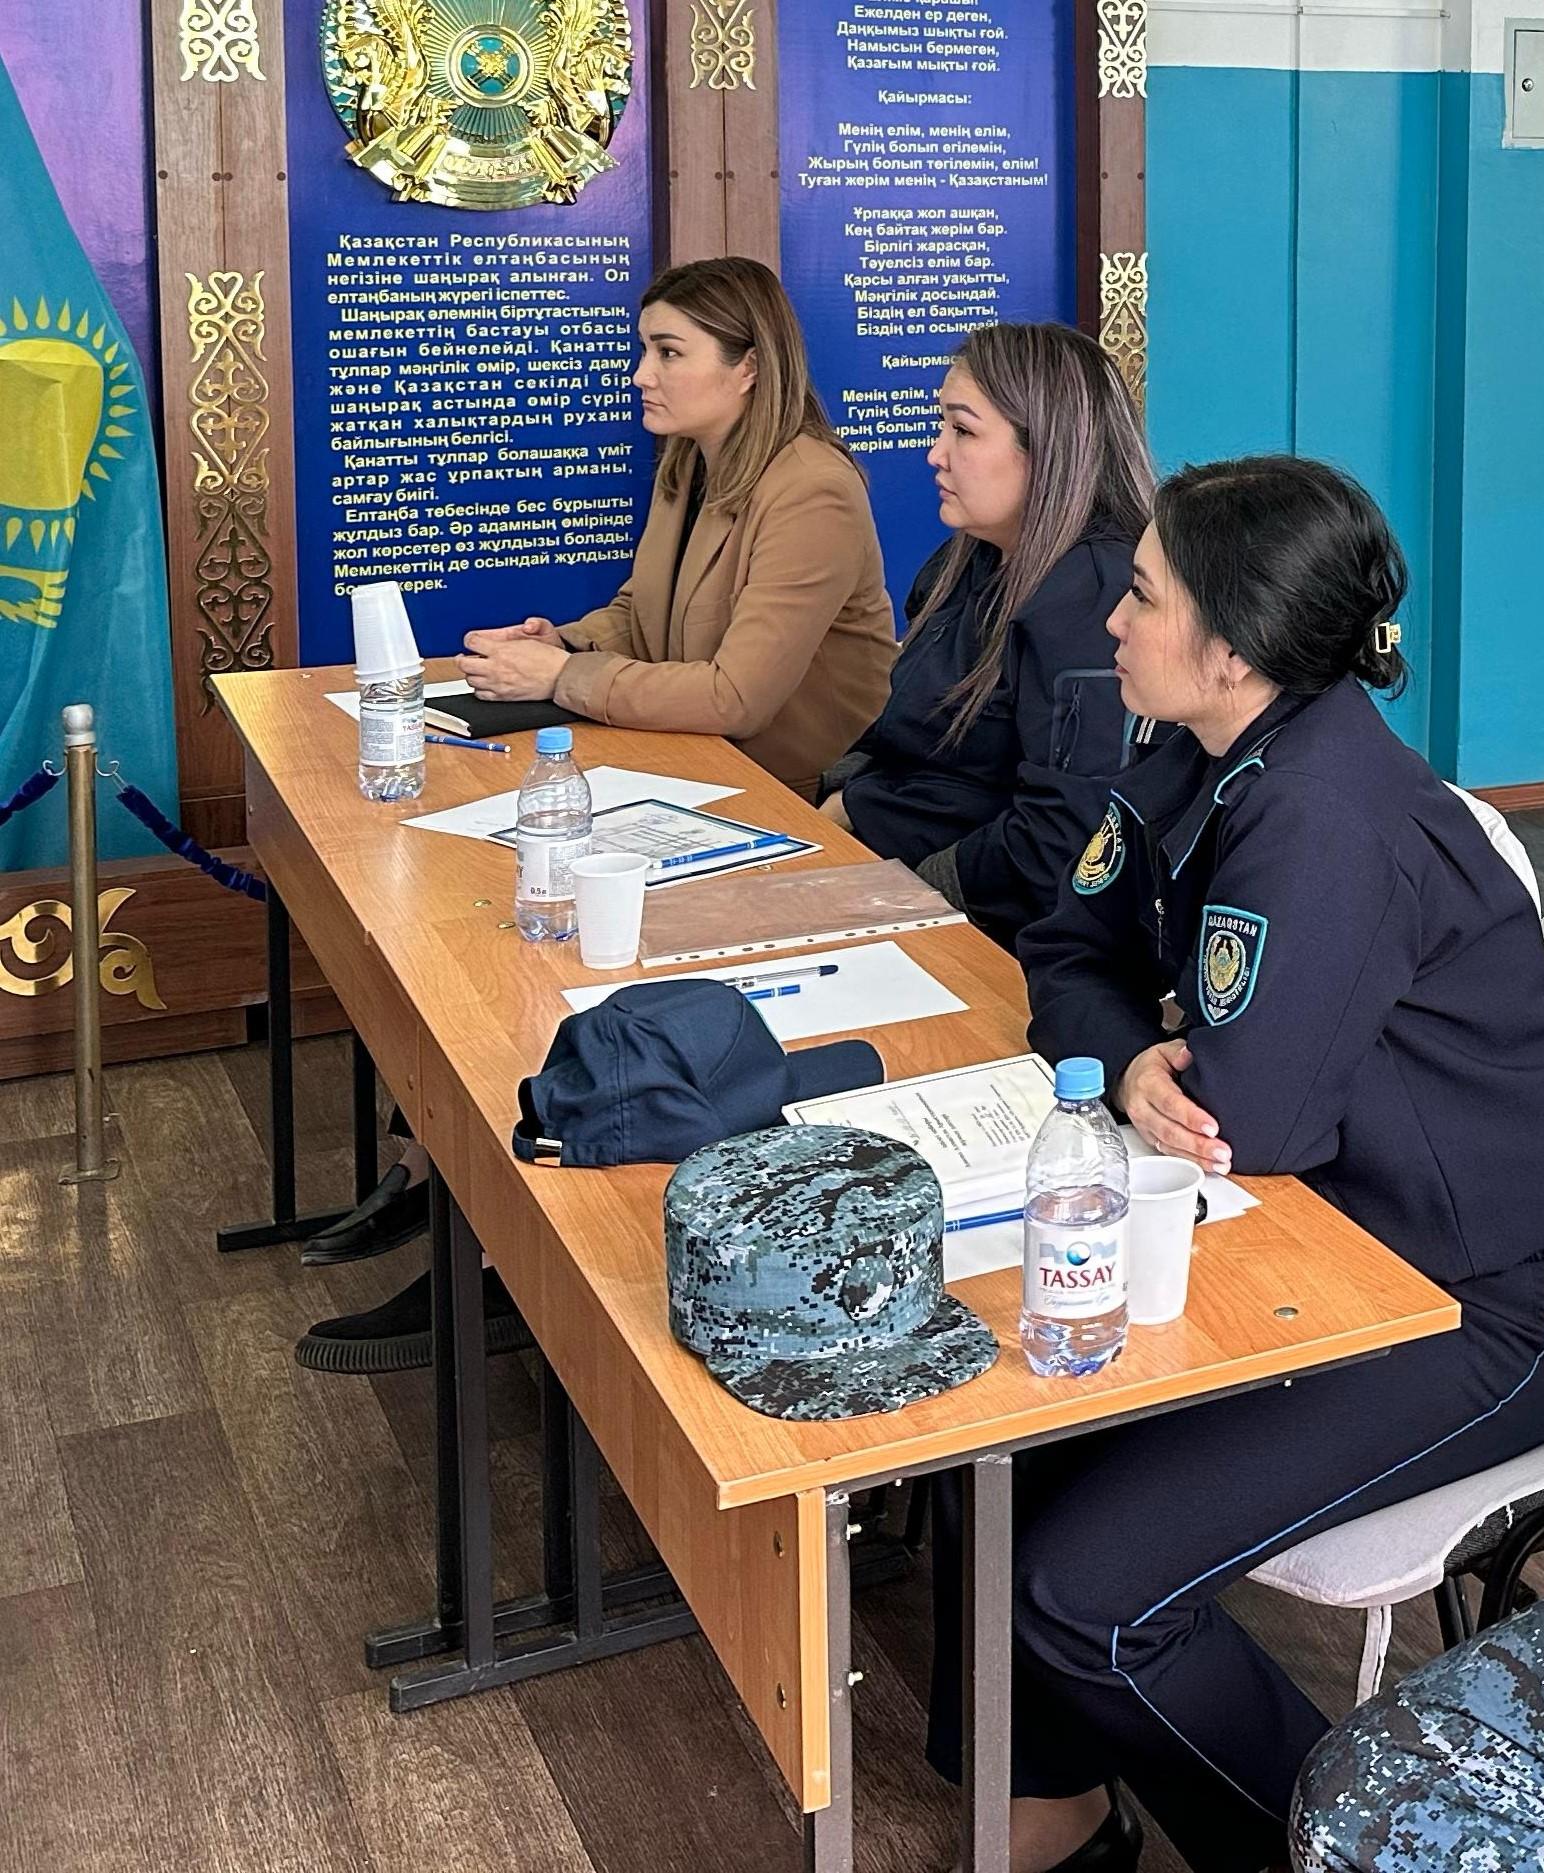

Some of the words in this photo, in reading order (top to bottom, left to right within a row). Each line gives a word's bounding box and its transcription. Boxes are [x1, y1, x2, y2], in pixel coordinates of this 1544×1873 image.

[854, 4, 921, 22] Ежелден
[924, 10, 943, 24] ер
[945, 11, 992, 24] деген,
[836, 20, 920, 37] Даңқымыз
[923, 27, 976, 40] шықты
[979, 26, 1009, 40] ғой.
[847, 38, 923, 54] Намысын
[926, 40, 1000, 58] бермеген,
[847, 55, 913, 71] Қазағым
[916, 60, 968, 73] мықты
[971, 59, 1001, 72] ғой.
[878, 89, 972, 107] Қайырмасы:
[838, 122, 884, 138] Менің
[886, 123, 925, 138] елім,
[929, 124, 972, 139] менің
[974, 124, 1011, 139] елім,
[844, 139, 886, 156] Гүлің
[888, 139, 939, 153] болып
[942, 140, 1007, 156] егілемін,
[807, 156, 870, 172] Жырың
[872, 156, 923, 170] болып
[926, 157, 999, 172] төгілемін,
[1002, 157, 1039, 170] елім!
[797, 173, 841, 189] Туған
[844, 173, 890, 189] жерім
[894, 173, 937, 188] менің
[853, 206, 914, 222] Ұрпаққа
[917, 209, 946, 219] жол
[949, 208, 999, 221] ашқан,
[844, 223, 873, 238] Кең
[876, 222, 928, 238] байтақ
[930, 222, 974, 238] жерім
[977, 221, 1008, 237] бар.
[339, 234, 439, 251] Қазақстан
[864, 239, 913, 255] Бірлігі
[916, 241, 990, 255] жарасқан,
[326, 251, 462, 267] Мемлекеттік
[858, 255, 924, 272] Тәуелсіз
[927, 255, 961, 268] елім
[964, 254, 995, 270] бар.
[327, 270, 403, 286] негізіне
[413, 272, 501, 287] шаңырақ
[509, 271, 595, 283] алынған.
[604, 268, 630, 282] Ол
[844, 273, 893, 289] Қарсы
[897, 274, 939, 285] алған
[942, 273, 1010, 287] уақытты,
[327, 288, 437, 306] елтаңбаның
[437, 287, 493, 305] жүрегі
[496, 287, 570, 301] іспеттес.
[854, 288, 918, 304] Мәңгілік
[920, 286, 1000, 303] досындай.
[340, 307, 426, 325] Шаңырақ
[427, 305, 498, 321] әлемнің
[857, 305, 905, 321] Біздің
[907, 307, 926, 318] ел
[929, 304, 998, 318] бақытты,
[465, 323, 549, 340] бастауы
[559, 321, 631, 336] отбасы
[856, 322, 904, 337] Біздің
[906, 323, 926, 335] ел
[328, 346, 407, 360] ошағын
[418, 340, 539, 357] бейнелейді.
[550, 339, 631, 356] Қанатты
[328, 364, 392, 381] тұлпар
[398, 359, 470, 377] мәңгілік
[476, 358, 521, 376] өмір,
[527, 356, 583, 372] шексіз
[588, 358, 631, 372] даму
[882, 354, 957, 370] Қайырмас
[328, 383, 382, 397] және
[394, 379, 503, 396] Қазақстан
[513, 373, 589, 390] секілді
[600, 373, 632, 390] бір
[842, 388, 888, 403] Менің
[890, 386, 929, 401] елім,
[330, 400, 422, 416] шаңырақ
[431, 396, 517, 411] астында
[526, 392, 571, 409] өмір
[581, 390, 632, 408] сүріп
[329, 419, 403, 433] жатқан
[563, 410, 632, 427] рухани
[847, 404, 890, 422] Гүлің
[875, 420, 926, 434] болып
[330, 435, 450, 451] байлығының
[450, 429, 514, 446] белгісі.
[848, 437, 894, 454] жерім
[344, 454, 419, 471] Қанатты
[426, 451, 489, 467] тұлпар
[497, 446, 589, 462] болашаққа
[597, 442, 633, 460] үміт
[331, 473, 390, 491] артар
[399, 471, 437, 484] жас
[447, 466, 543, 485] ұрпақтың
[552, 462, 633, 479] арманы,
[331, 491, 394, 507] самғау
[395, 486, 440, 503] биігі.
[345, 505, 419, 523] Елтаңба
[424, 502, 511, 519] төбесінде
[516, 499, 547, 514] бес
[551, 496, 633, 514] бұрышты
[332, 527, 403, 545] жұлдыз
[407, 523, 444, 540] бар.
[449, 520, 474, 538] Әр
[477, 518, 558, 535] адамның
[560, 512, 634, 530] өмірінде
[332, 547, 368, 561] жол
[372, 542, 452, 560] көрсетер
[454, 540, 475, 553] өз
[478, 535, 560, 553] жұлдызы
[563, 531, 633, 546] болады.
[447, 559, 470, 573] де
[473, 550, 550, 569] осындай
[553, 549, 633, 566] жұлдызы
[1207, 915, 1258, 937] QAZAQSTAN
[1039, 1261, 1117, 1289] TASSAY
